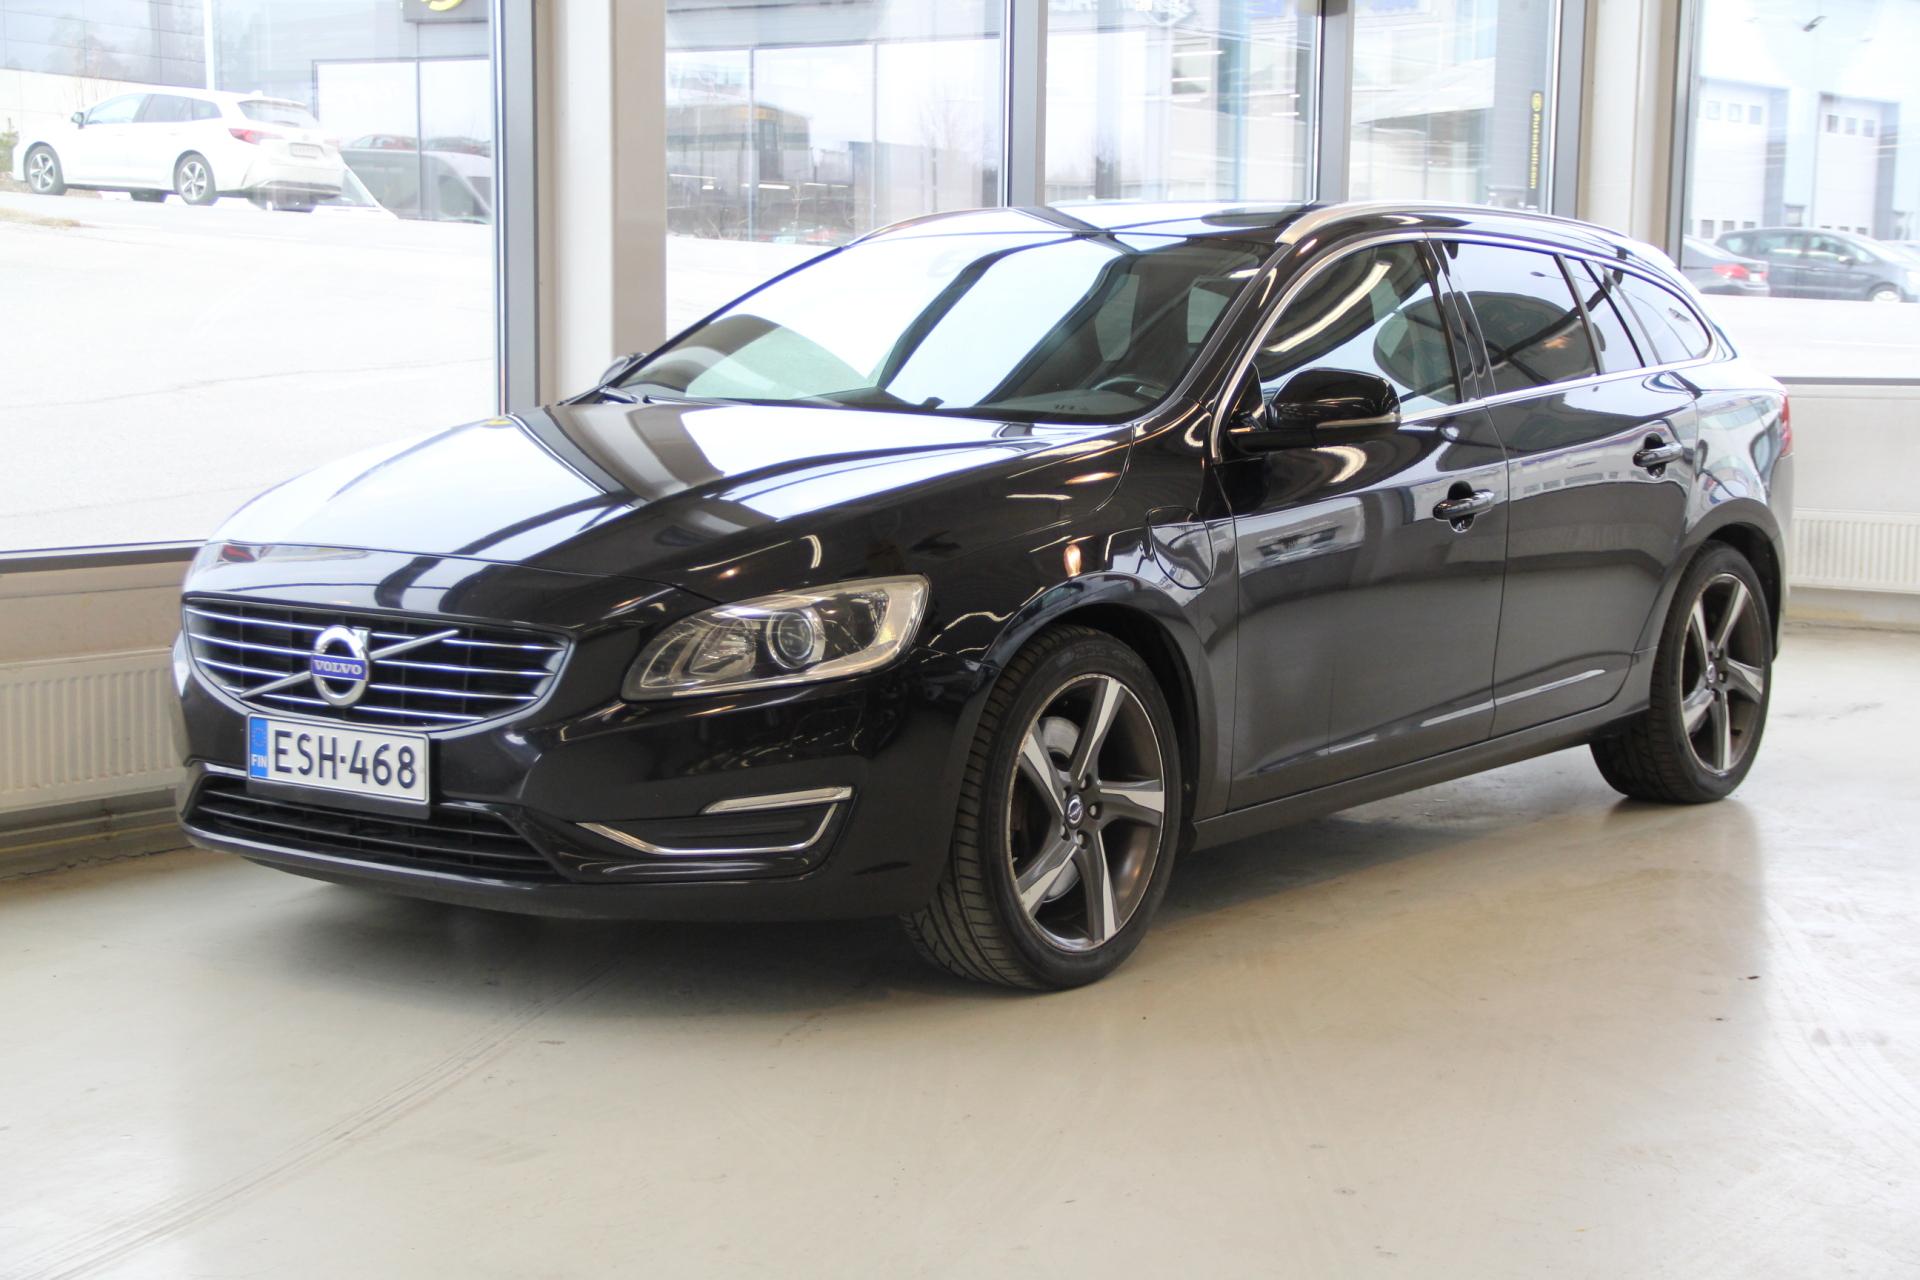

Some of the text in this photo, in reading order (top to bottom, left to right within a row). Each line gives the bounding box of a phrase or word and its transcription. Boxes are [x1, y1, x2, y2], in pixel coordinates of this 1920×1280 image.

[313, 660, 362, 675] VOLVO
[251, 754, 267, 769] FIN
[274, 730, 416, 789] ESH-468
